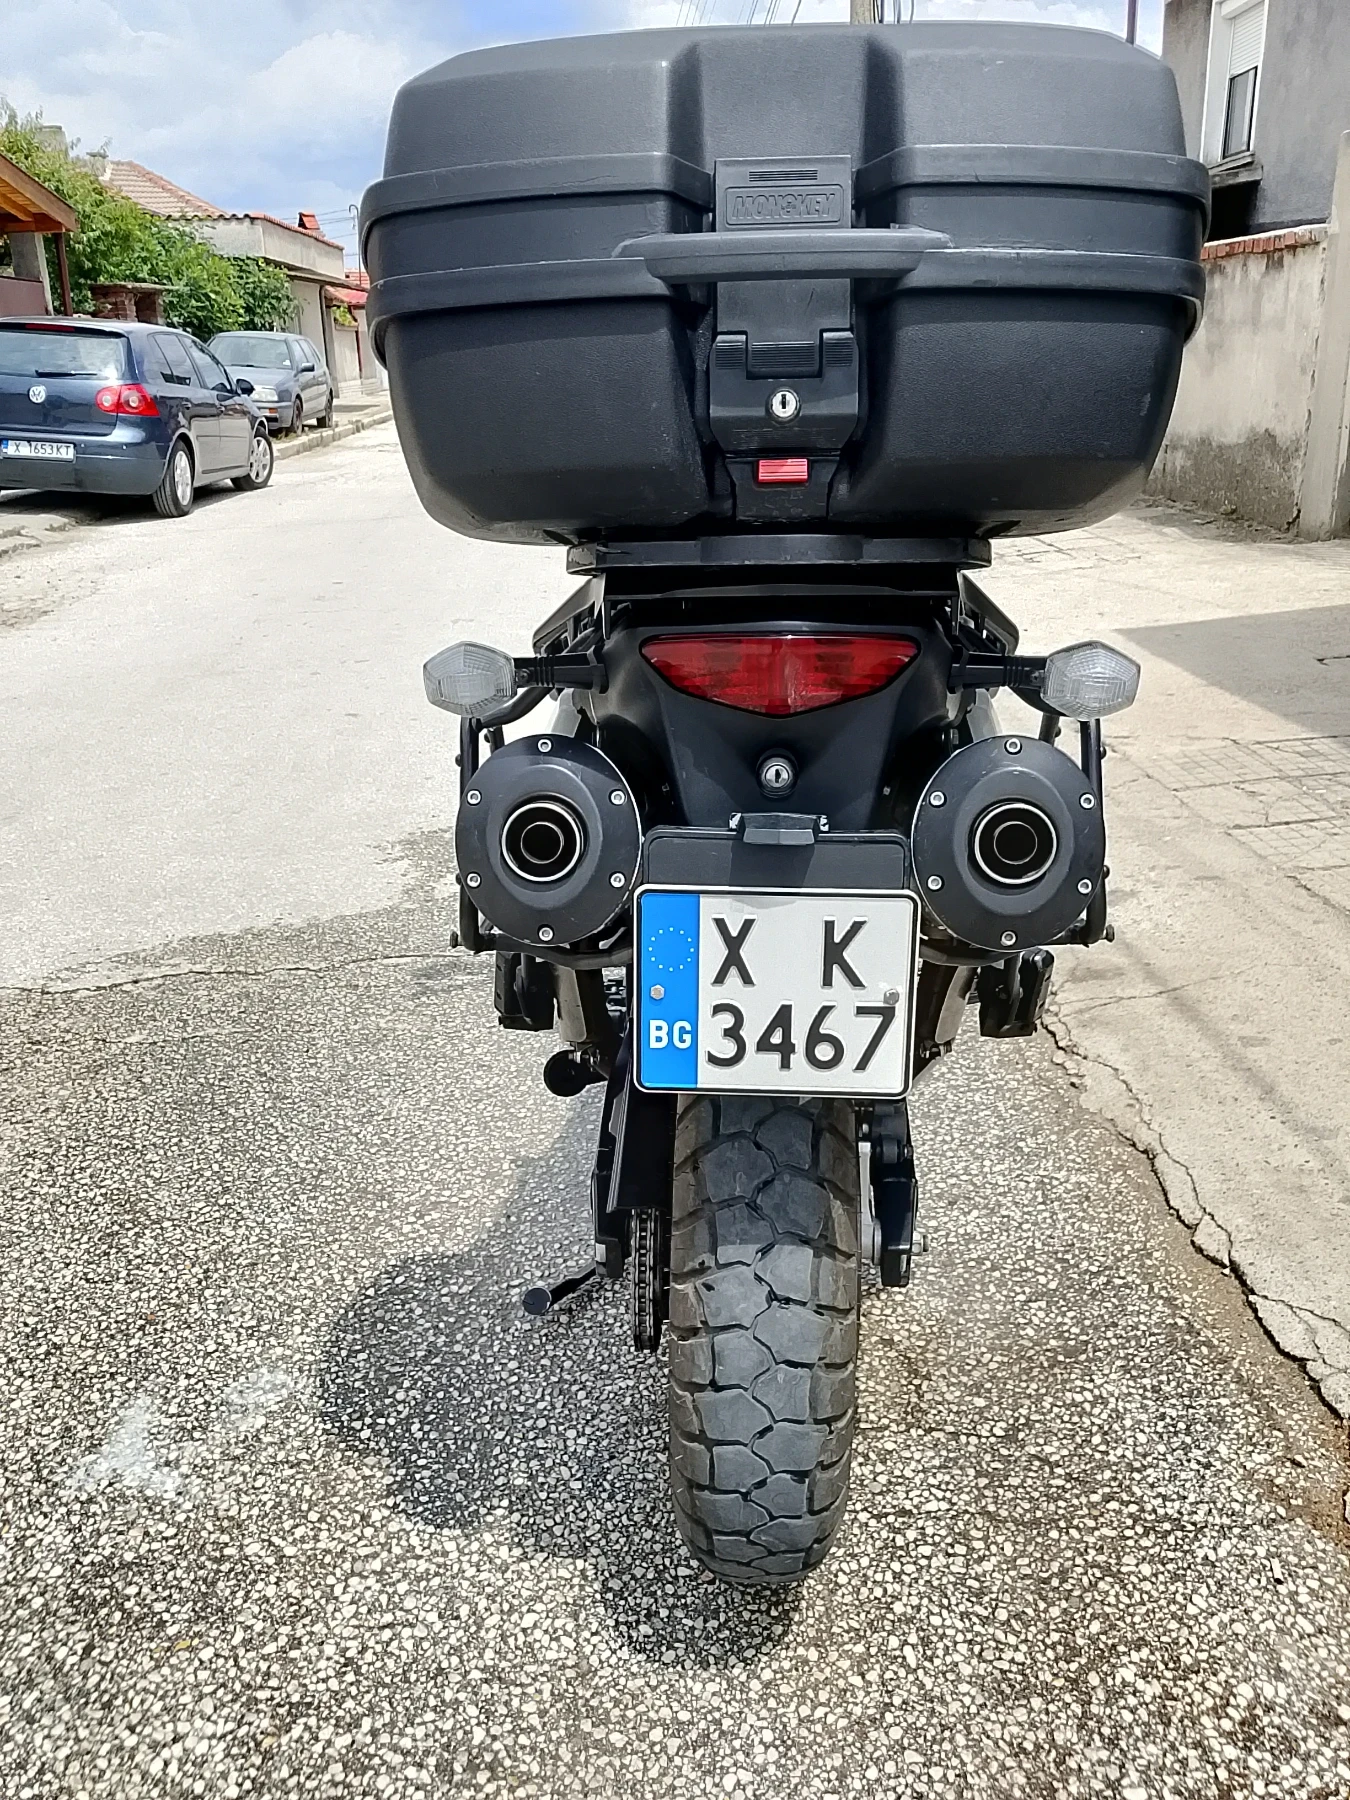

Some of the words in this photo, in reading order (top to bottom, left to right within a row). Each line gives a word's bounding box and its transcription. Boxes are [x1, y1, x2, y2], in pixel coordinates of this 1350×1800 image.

[711, 914, 757, 987] X
[821, 915, 868, 989] K
[649, 1019, 692, 1049] BG
[705, 999, 896, 1073] 3467
